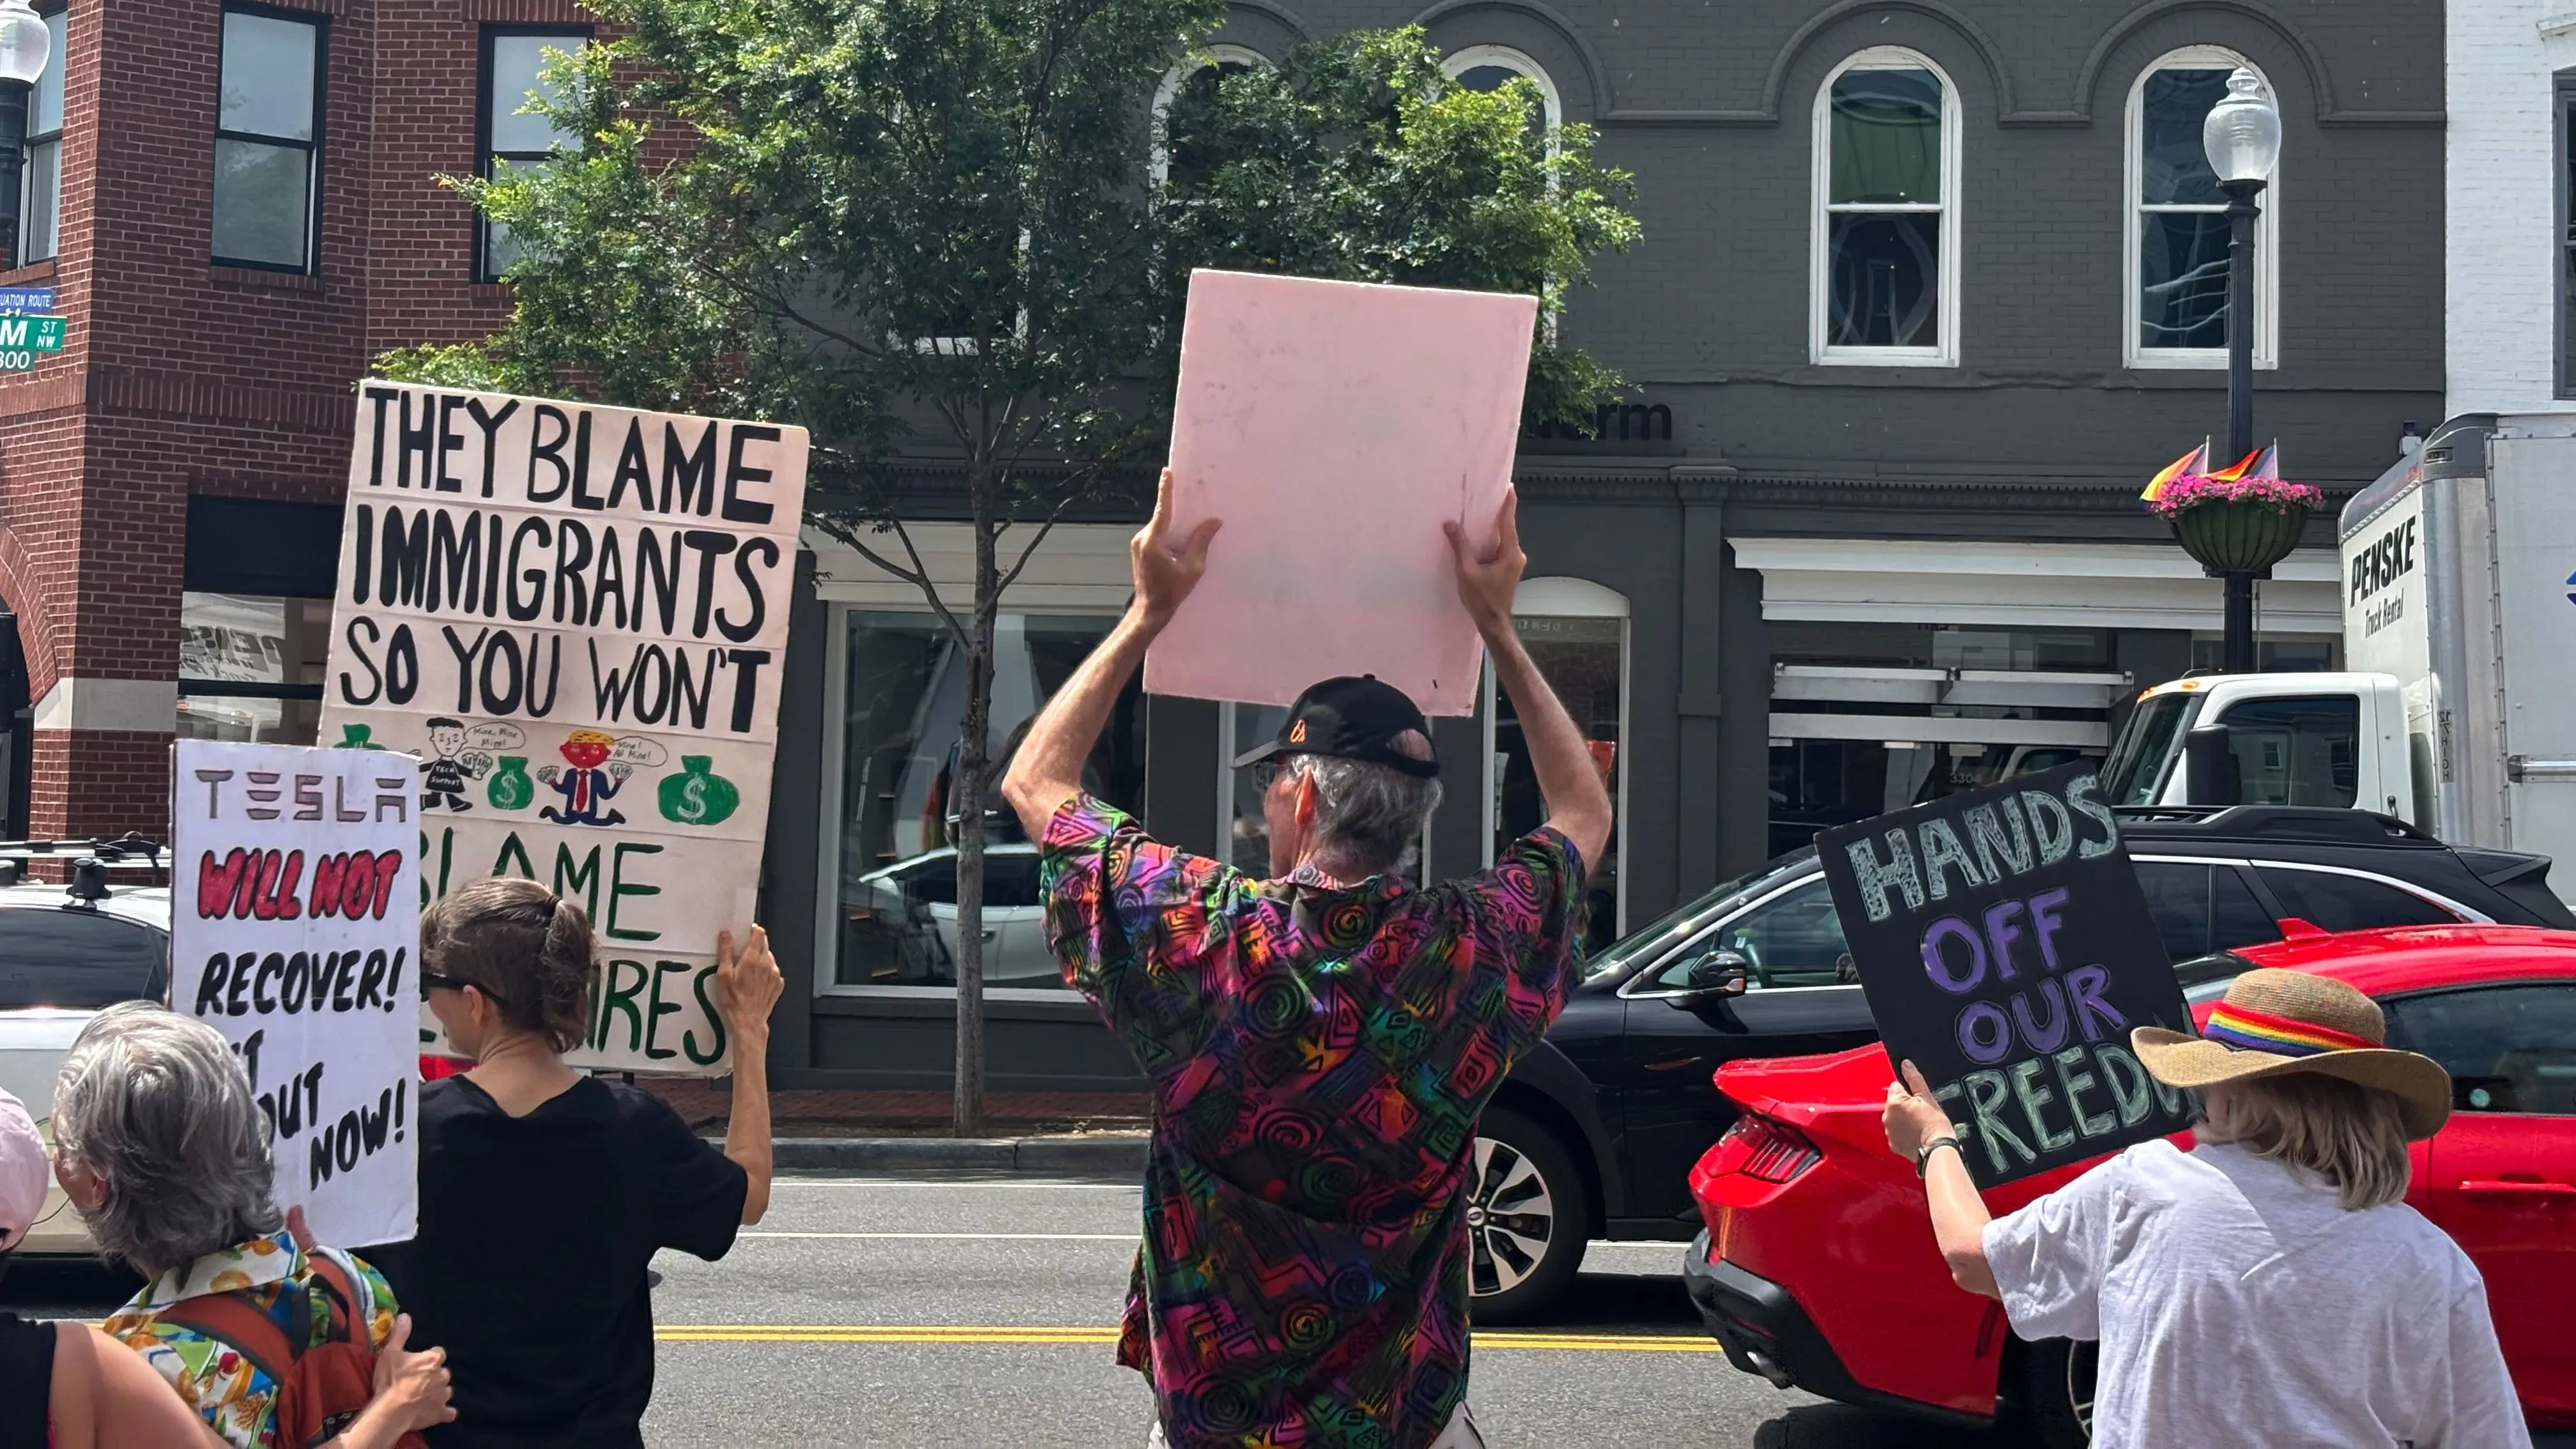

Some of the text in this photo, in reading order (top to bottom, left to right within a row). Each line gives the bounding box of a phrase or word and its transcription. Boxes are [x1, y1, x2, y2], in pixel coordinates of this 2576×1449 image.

[0, 294, 51, 307] UATION ROUTE
[0, 319, 57, 346] M ST
[36, 335, 56, 348] NW
[365, 387, 781, 525] THEY BLAME
[353, 504, 779, 643] IMMIGRANTS
[2350, 515, 2416, 608] PENSKE
[2365, 587, 2405, 639] Truck Rental
[339, 616, 418, 706] SO
[441, 625, 560, 718] YOU
[588, 637, 771, 733] WON'T
[195, 769, 406, 822] TESLA
[196, 847, 402, 921] WILL NOT
[1845, 774, 2118, 922] HANDS
[195, 946, 406, 1016] RECOVER!
[1920, 886, 2069, 995] OFF
[1955, 964, 2129, 1064] OUR
[310, 1077, 406, 1192] NOW!
[1932, 1009, 2209, 1174] REED
